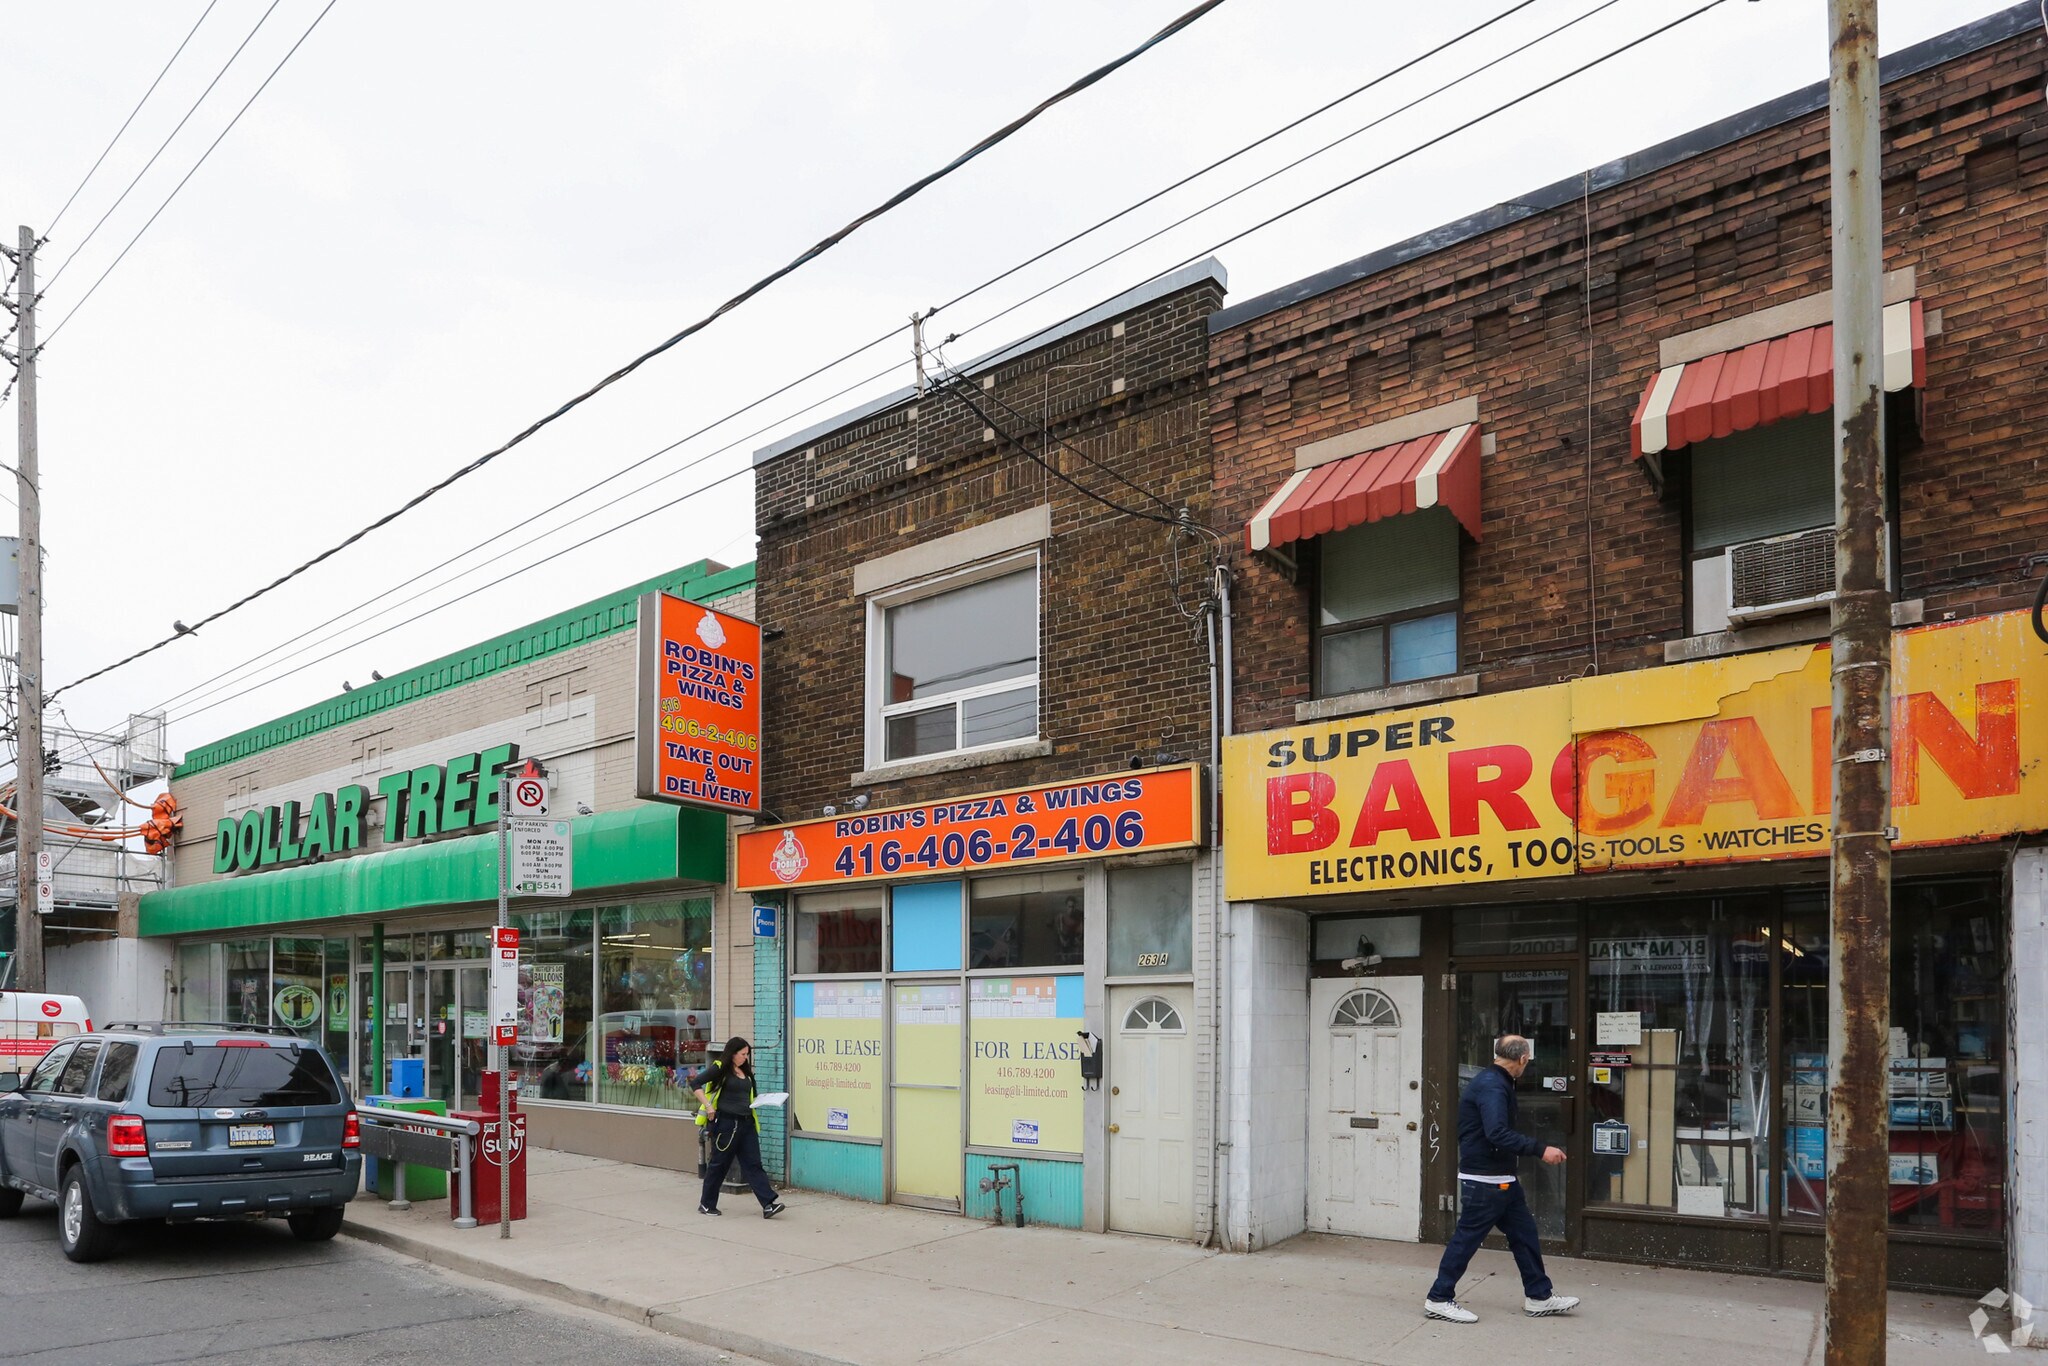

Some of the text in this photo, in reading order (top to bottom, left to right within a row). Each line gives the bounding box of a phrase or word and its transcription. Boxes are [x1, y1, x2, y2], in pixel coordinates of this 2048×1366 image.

[665, 639, 755, 680] ROBIN'S
[667, 660, 746, 695] PIZZA &
[661, 697, 681, 712] 416
[677, 680, 744, 710] WINGS
[661, 714, 758, 751] 406-2-406
[1266, 716, 1457, 768] SUPER
[666, 742, 753, 775] TAKE OUT
[704, 767, 717, 784] &
[666, 775, 752, 806] DELIVERY
[213, 742, 520, 874] DOLLAR TREE
[835, 778, 1143, 839] ROBIN'S PIZZA & WINGS
[834, 810, 1145, 878] 416-406-2-406
[1309, 845, 1494, 885] ELECTRONICS,
[536, 881, 562, 890] 5541
[758, 918, 775, 927] Phone
[533, 972, 563, 982] BALLOONS
[797, 1038, 882, 1057] FOR LEASE
[974, 1041, 1081, 1061] FOR LEASE
[815, 1061, 862, 1073] 416.789.4200
[996, 1066, 1056, 1079] 416.789.4200
[984, 1083, 1069, 1099] leasing@li-limited.com
[303, 1152, 333, 1162] BEACH
